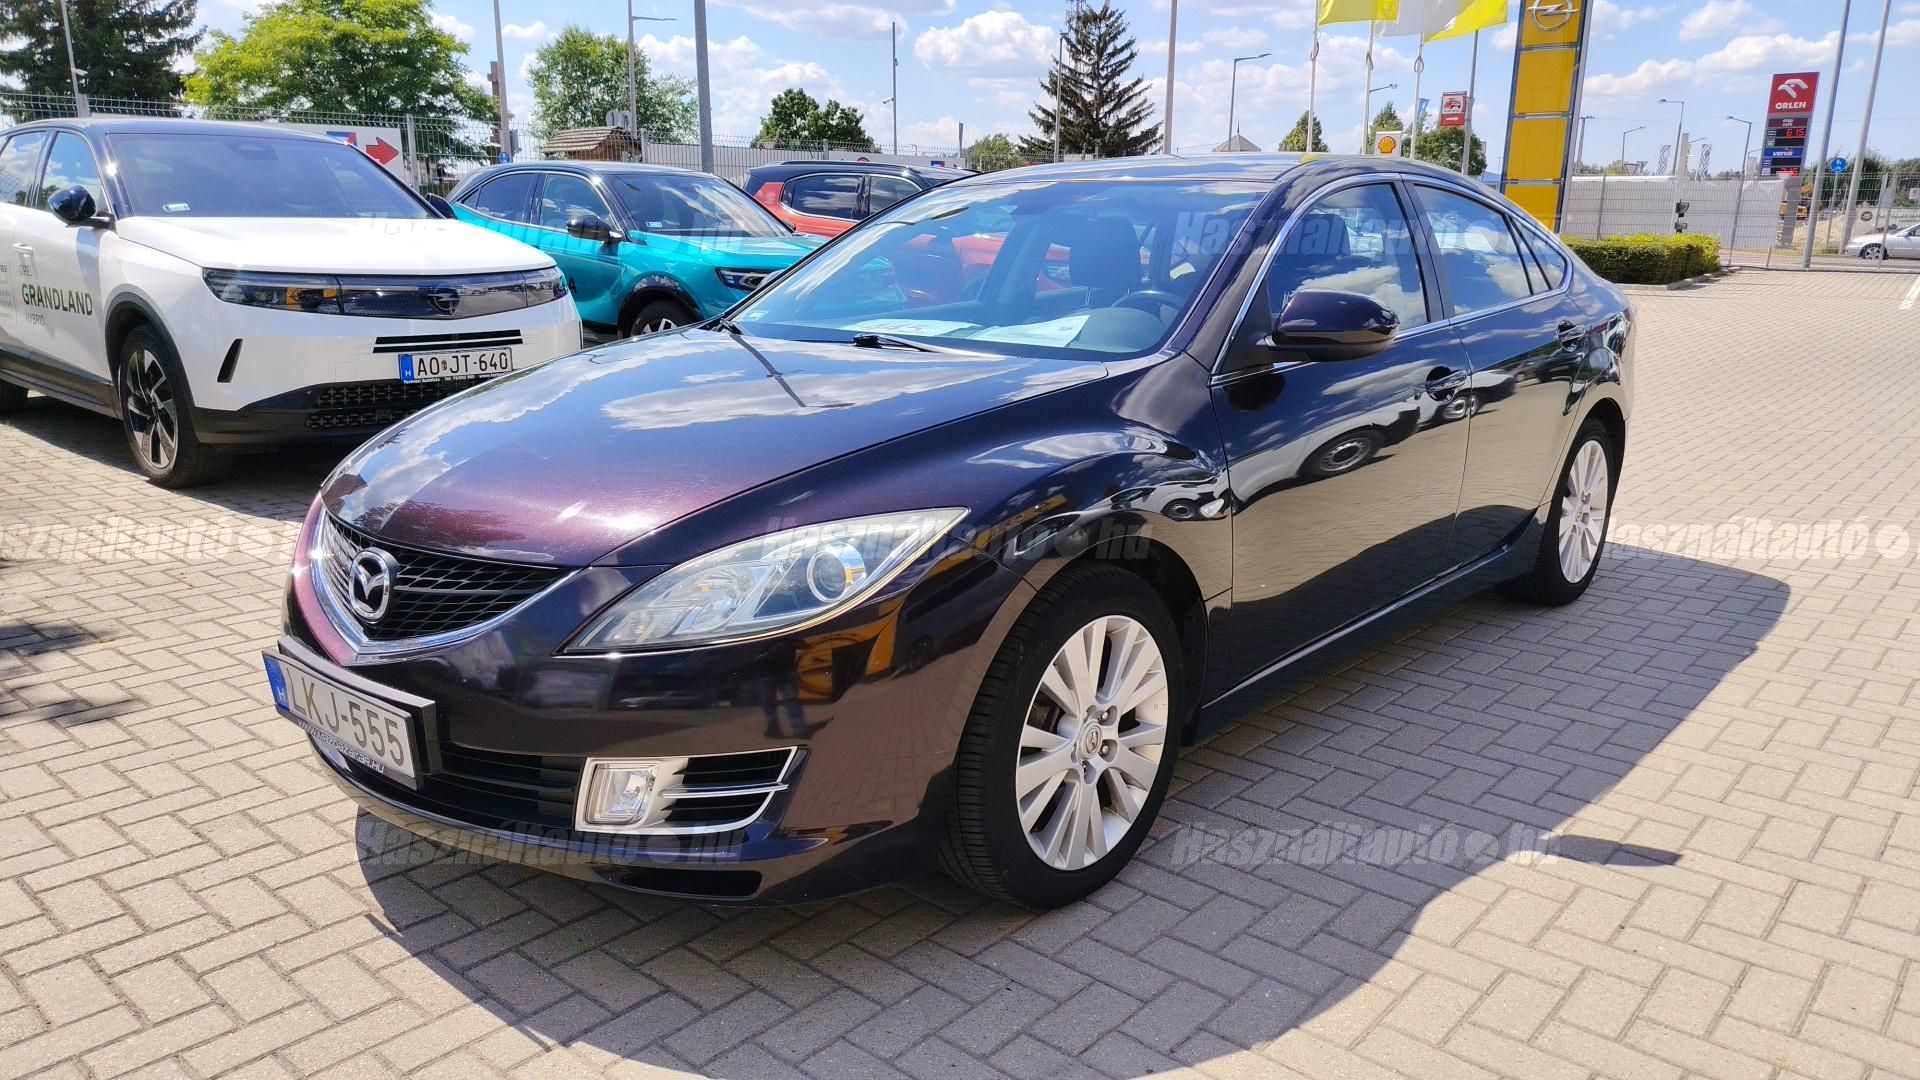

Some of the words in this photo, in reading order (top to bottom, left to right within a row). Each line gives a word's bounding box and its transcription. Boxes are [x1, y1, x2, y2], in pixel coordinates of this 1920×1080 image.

[1775, 101, 1807, 110] ORLEN
[21, 283, 94, 316] GRANDLAND
[277, 686, 285, 698] H
[286, 667, 405, 767] LKJ-555
